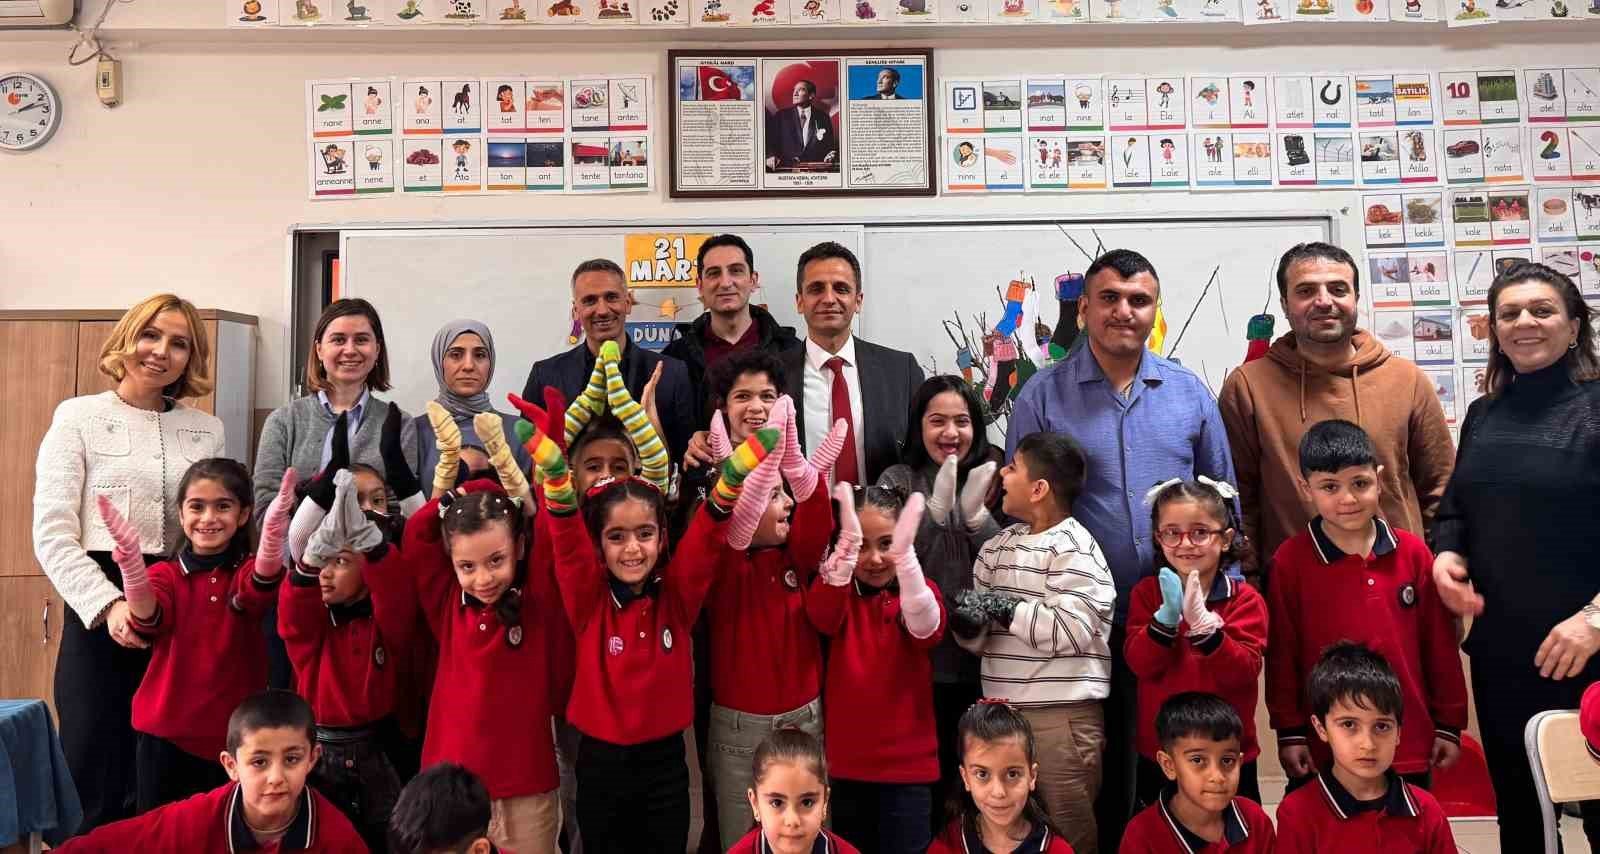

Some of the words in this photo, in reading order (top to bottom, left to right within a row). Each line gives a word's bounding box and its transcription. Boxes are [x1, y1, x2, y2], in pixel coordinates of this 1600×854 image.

[13, 80, 23, 89] 12
[1, 86, 8, 94] 11
[1394, 86, 1429, 96] SATILIK
[1446, 82, 1471, 98] 10
[37, 93, 45, 101] 2
[41, 105, 50, 113] 3
[582, 114, 600, 122] tane
[1160, 110, 1174, 121] Ela
[1243, 110, 1256, 119] Ali
[1286, 110, 1305, 119] atlet
[362, 117, 383, 126] anne
[415, 117, 430, 126] ana
[456, 116, 466, 125] at
[501, 116, 513, 124] tat
[539, 115, 552, 124] ten
[3, 131, 10, 139] 7
[16, 133, 24, 141] 6
[30, 129, 38, 137] 5
[1539, 130, 1561, 160] 2
[454, 172, 470, 181] Ata
[614, 171, 644, 180] tantana
[1161, 167, 1179, 177] Lale
[316, 177, 353, 186] anneanne
[364, 175, 384, 184] nene
[581, 173, 601, 181] tente
[1378, 228, 1392, 239] kek
[1503, 224, 1520, 235] toka
[654, 236, 686, 261] 21
[630, 259, 698, 282] MAR
